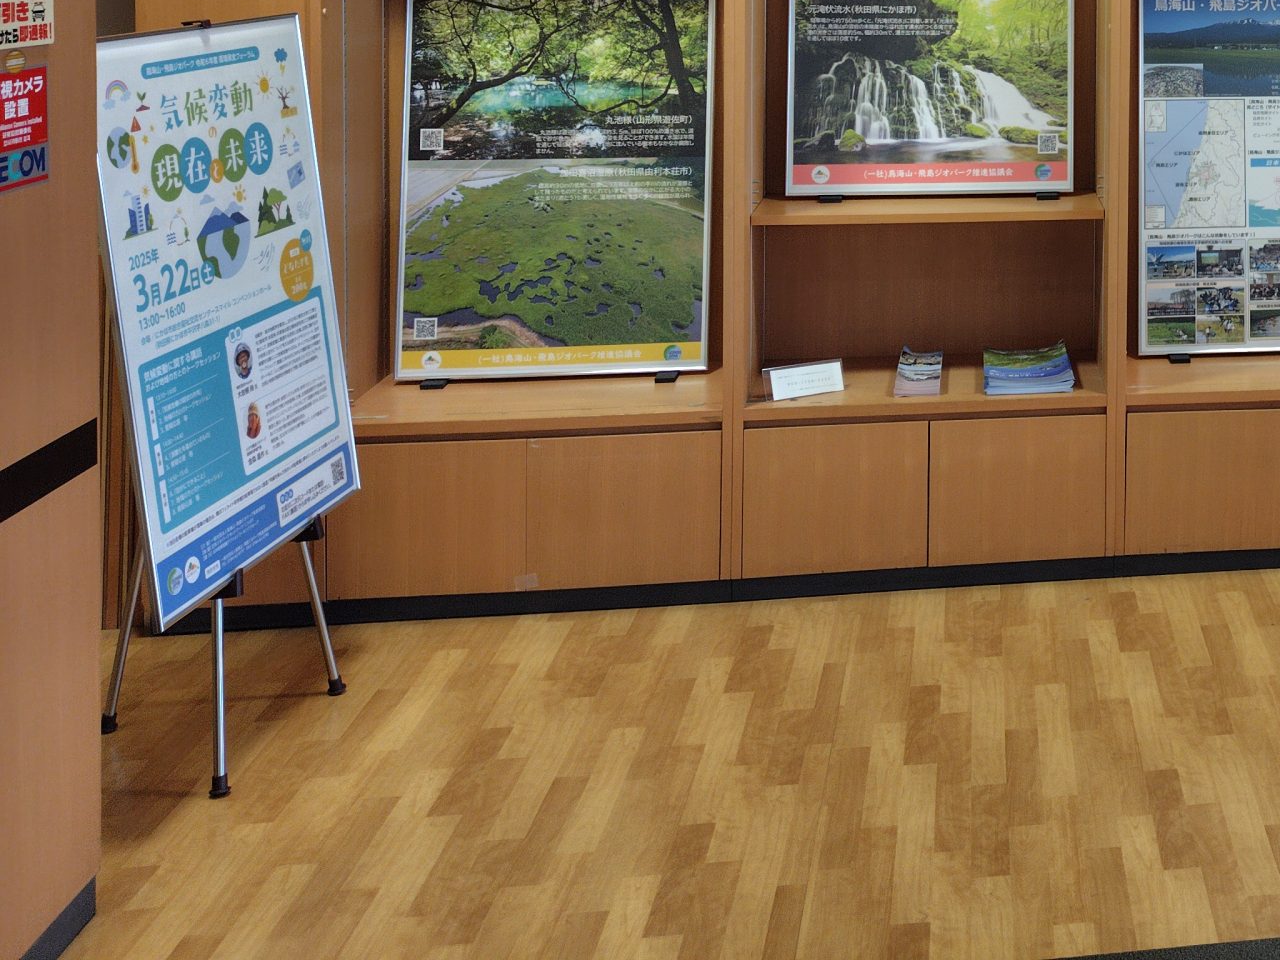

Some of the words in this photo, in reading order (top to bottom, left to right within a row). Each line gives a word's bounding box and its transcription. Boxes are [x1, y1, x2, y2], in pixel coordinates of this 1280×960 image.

[0, 1, 29, 23] 引き
[4, 98, 29, 120] 設置
[160, 80, 254, 132] 気候変動
[154, 131, 268, 191] 現在と未来
[128, 248, 160, 272] 2025年
